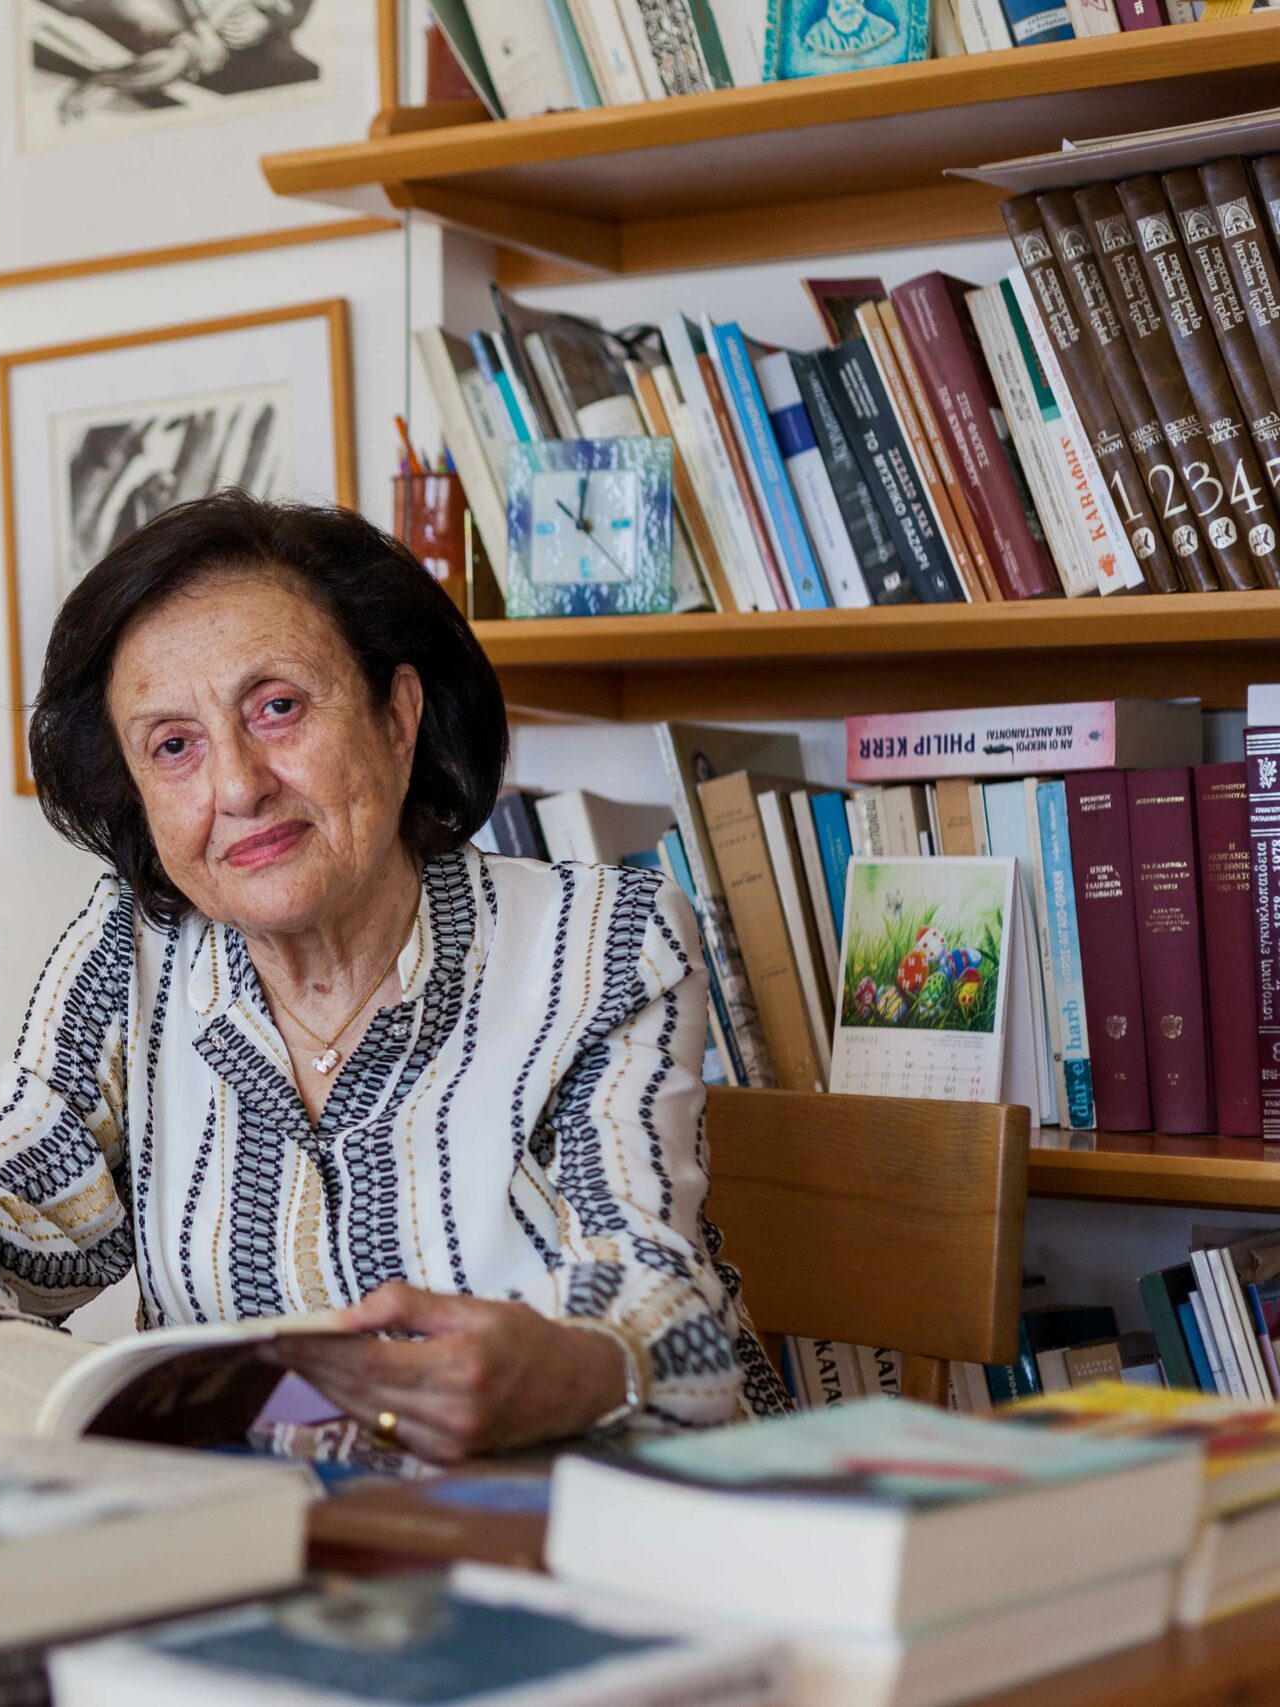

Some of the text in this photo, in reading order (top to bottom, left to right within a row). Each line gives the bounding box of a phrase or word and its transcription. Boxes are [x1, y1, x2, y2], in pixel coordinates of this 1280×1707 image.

[1209, 417, 1232, 436] γεφ
[863, 429, 879, 452] ΤΟ
[873, 453, 907, 517] ΜΥΣΤΙΚΟ
[1111, 470, 1144, 524] 1
[1148, 464, 1188, 519] 2
[1183, 461, 1224, 517] 3
[1230, 457, 1264, 514] 4
[859, 732, 976, 760] PHILIP KERR
[1016, 739, 1073, 753] ΑΝ ΟΙ ΝΕΚΡΟΙ
[1055, 725, 1073, 737] ΔΕΝ
[1062, 998, 1085, 1051] harb
[1070, 1076, 1090, 1119] dar
